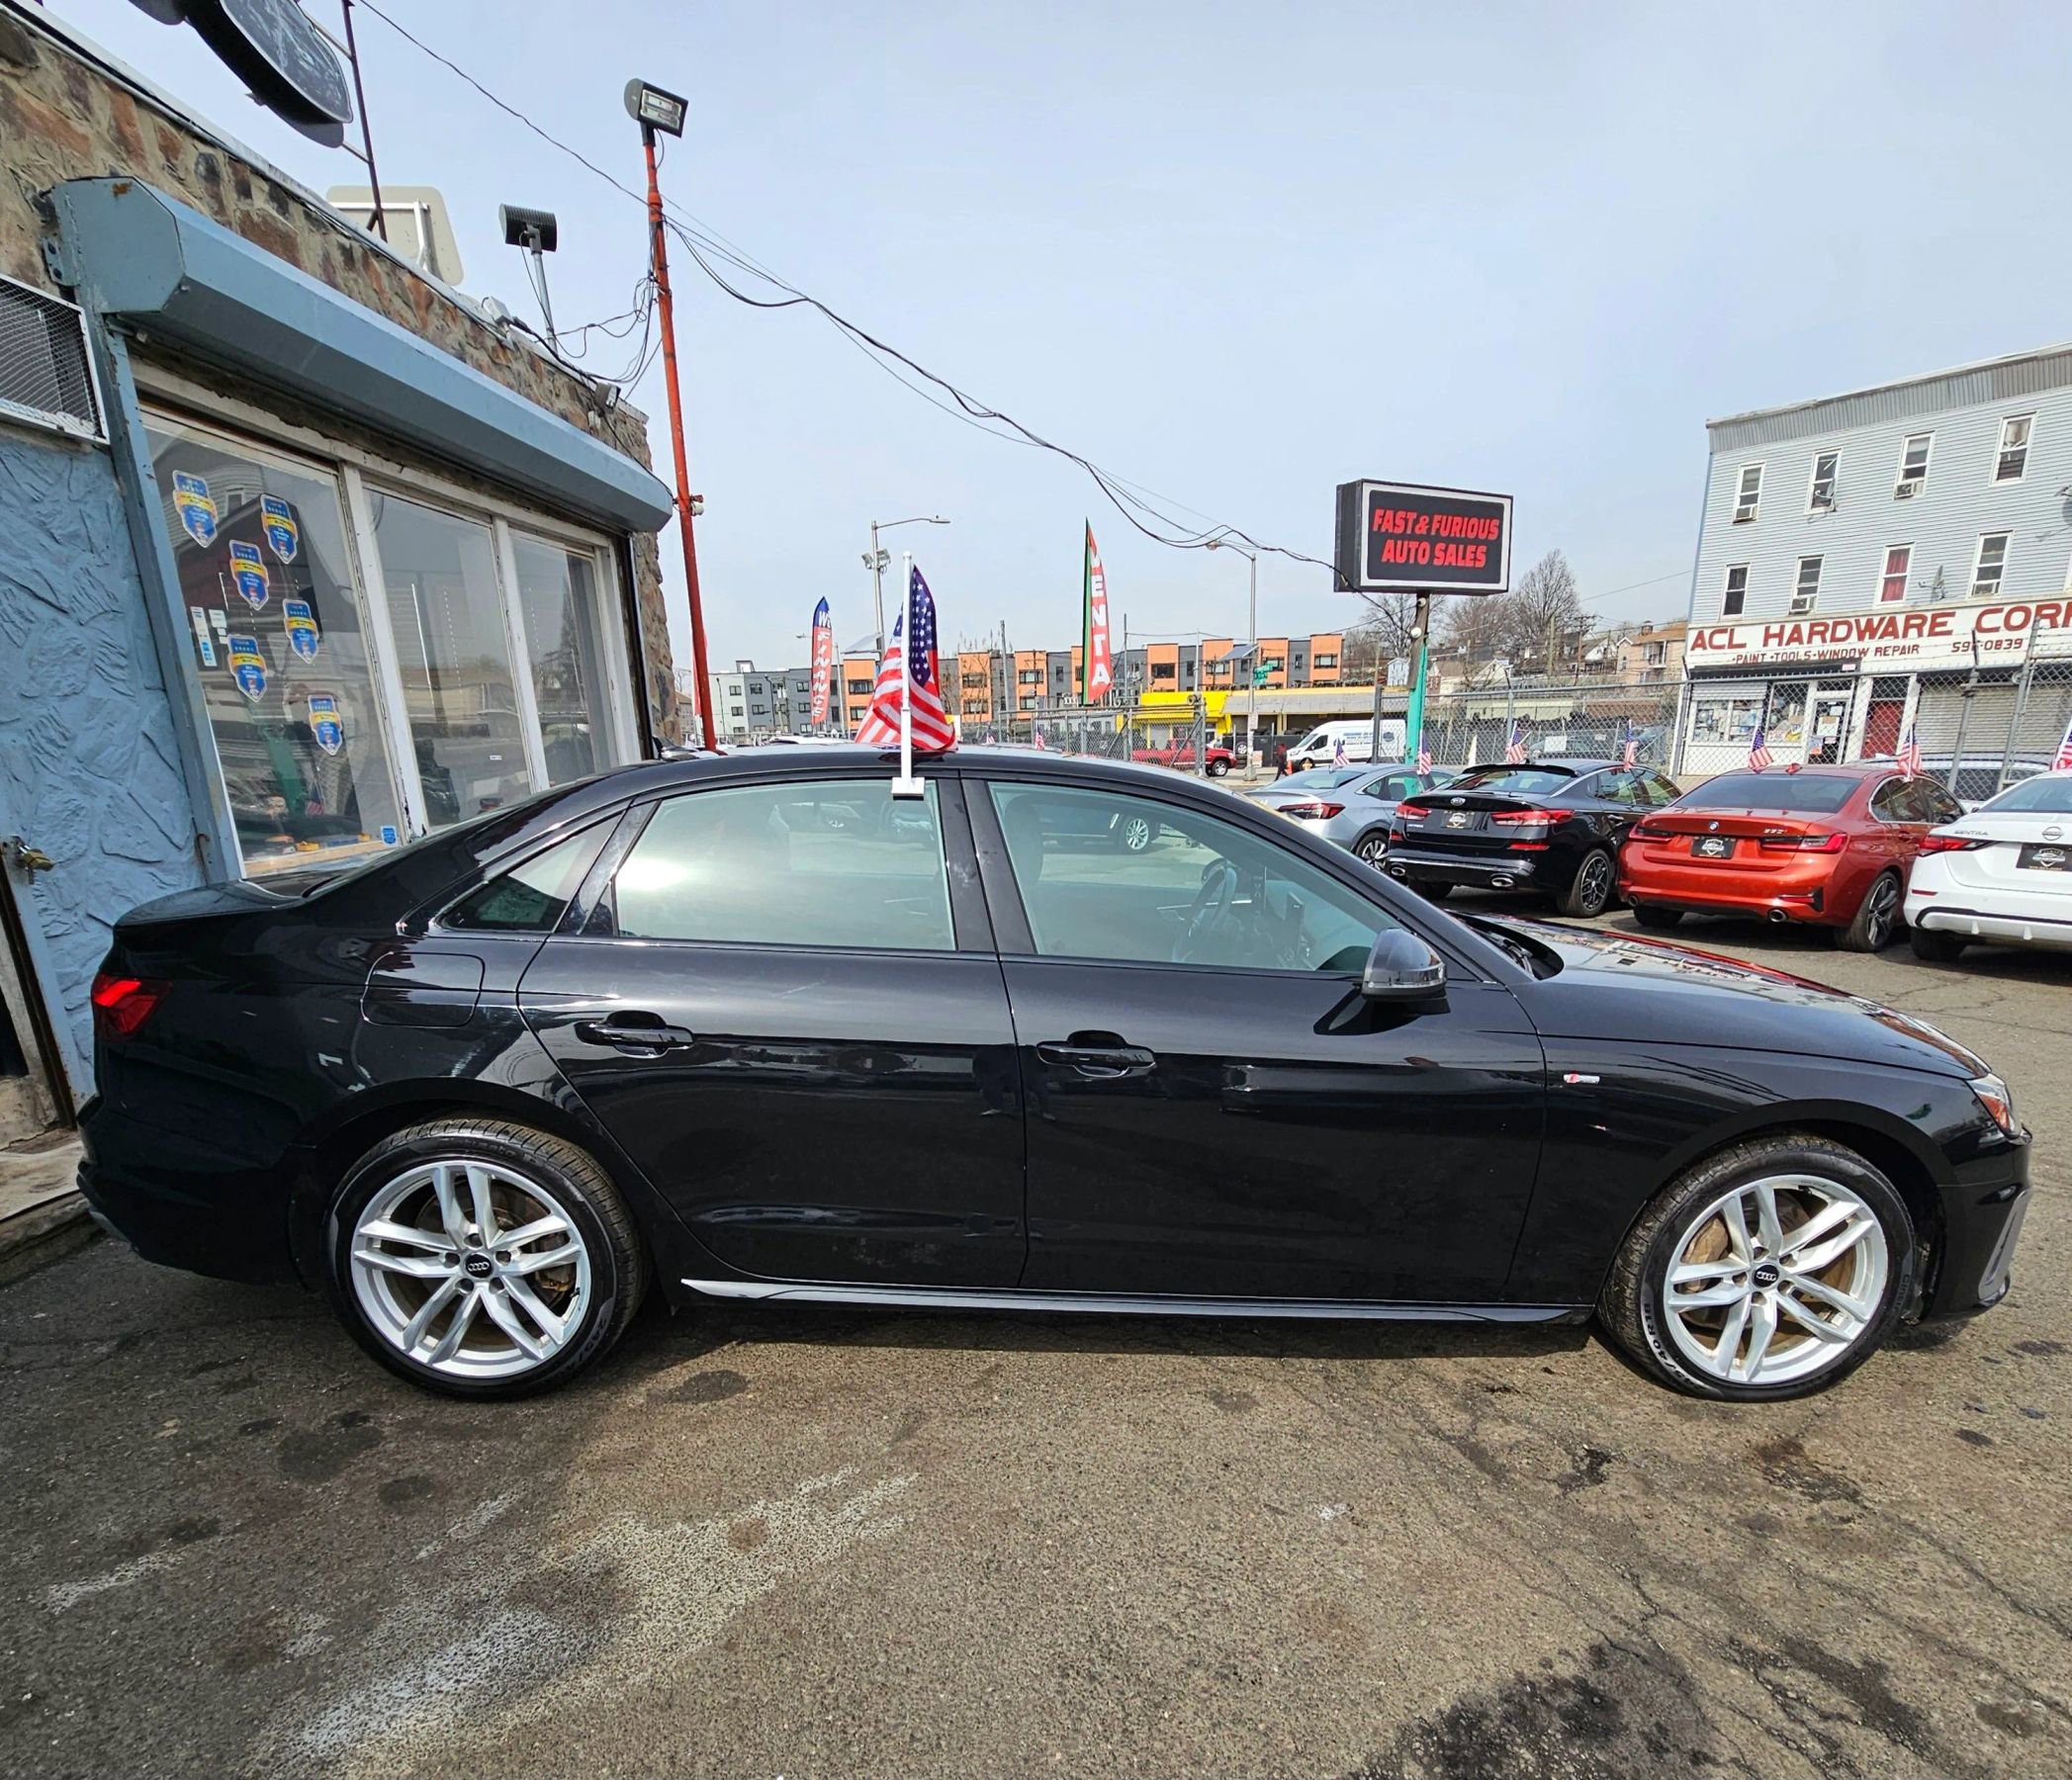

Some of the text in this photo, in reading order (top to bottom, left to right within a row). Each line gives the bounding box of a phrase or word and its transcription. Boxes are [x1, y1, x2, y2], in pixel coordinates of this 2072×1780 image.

[1373, 508, 1500, 541] FAST & FURIOUS
[1381, 539, 1487, 569] AUTO SALES
[1690, 628, 1747, 651] ACL
[1762, 610, 1956, 648] HARDWARE
[1736, 644, 1920, 664] PAINT TOOLS WINDOW REPAIR
[811, 631, 831, 717] FINANCE
